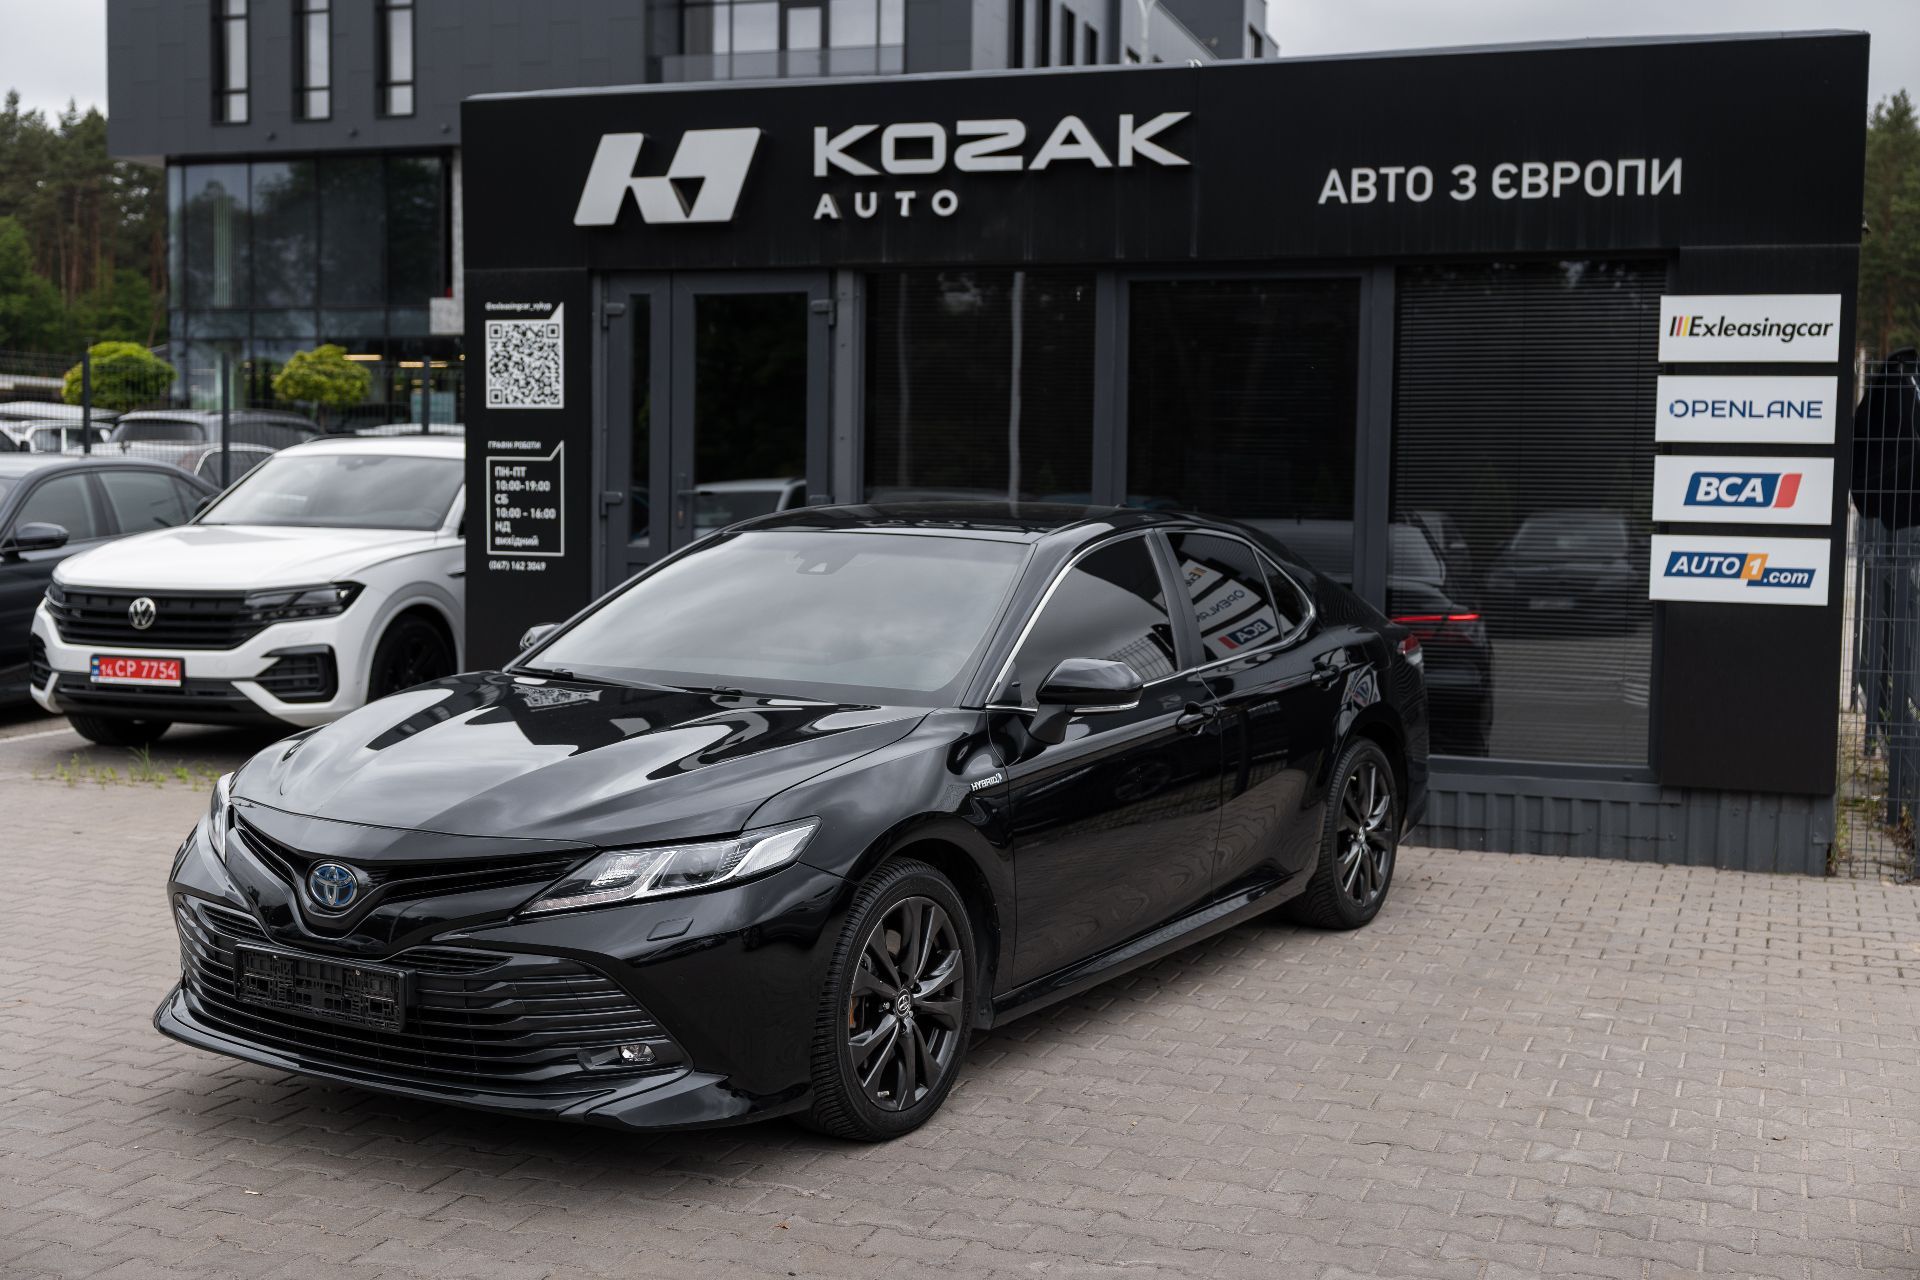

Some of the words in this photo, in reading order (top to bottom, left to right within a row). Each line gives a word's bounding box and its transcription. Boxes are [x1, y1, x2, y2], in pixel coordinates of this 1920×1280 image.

[813, 111, 1191, 177] KOZAK
[1318, 165, 1434, 205] АВТО
[1491, 157, 1683, 200] ЄВРОПИ
[813, 189, 959, 220] AUTO
[1688, 315, 1834, 343] Exleasingcar
[1669, 399, 1823, 419] OPENLANE
[494, 466, 527, 478] ПН-ПТ
[496, 480, 551, 492] 10:00-19:00
[1695, 476, 1765, 503] BCA
[494, 493, 510, 505] СБ
[496, 507, 521, 519] 10:00
[530, 508, 557, 519] 16:00
[494, 520, 512, 534] НД
[140, 660, 177, 680] 7754
[970, 776, 998, 791] HYBRID
